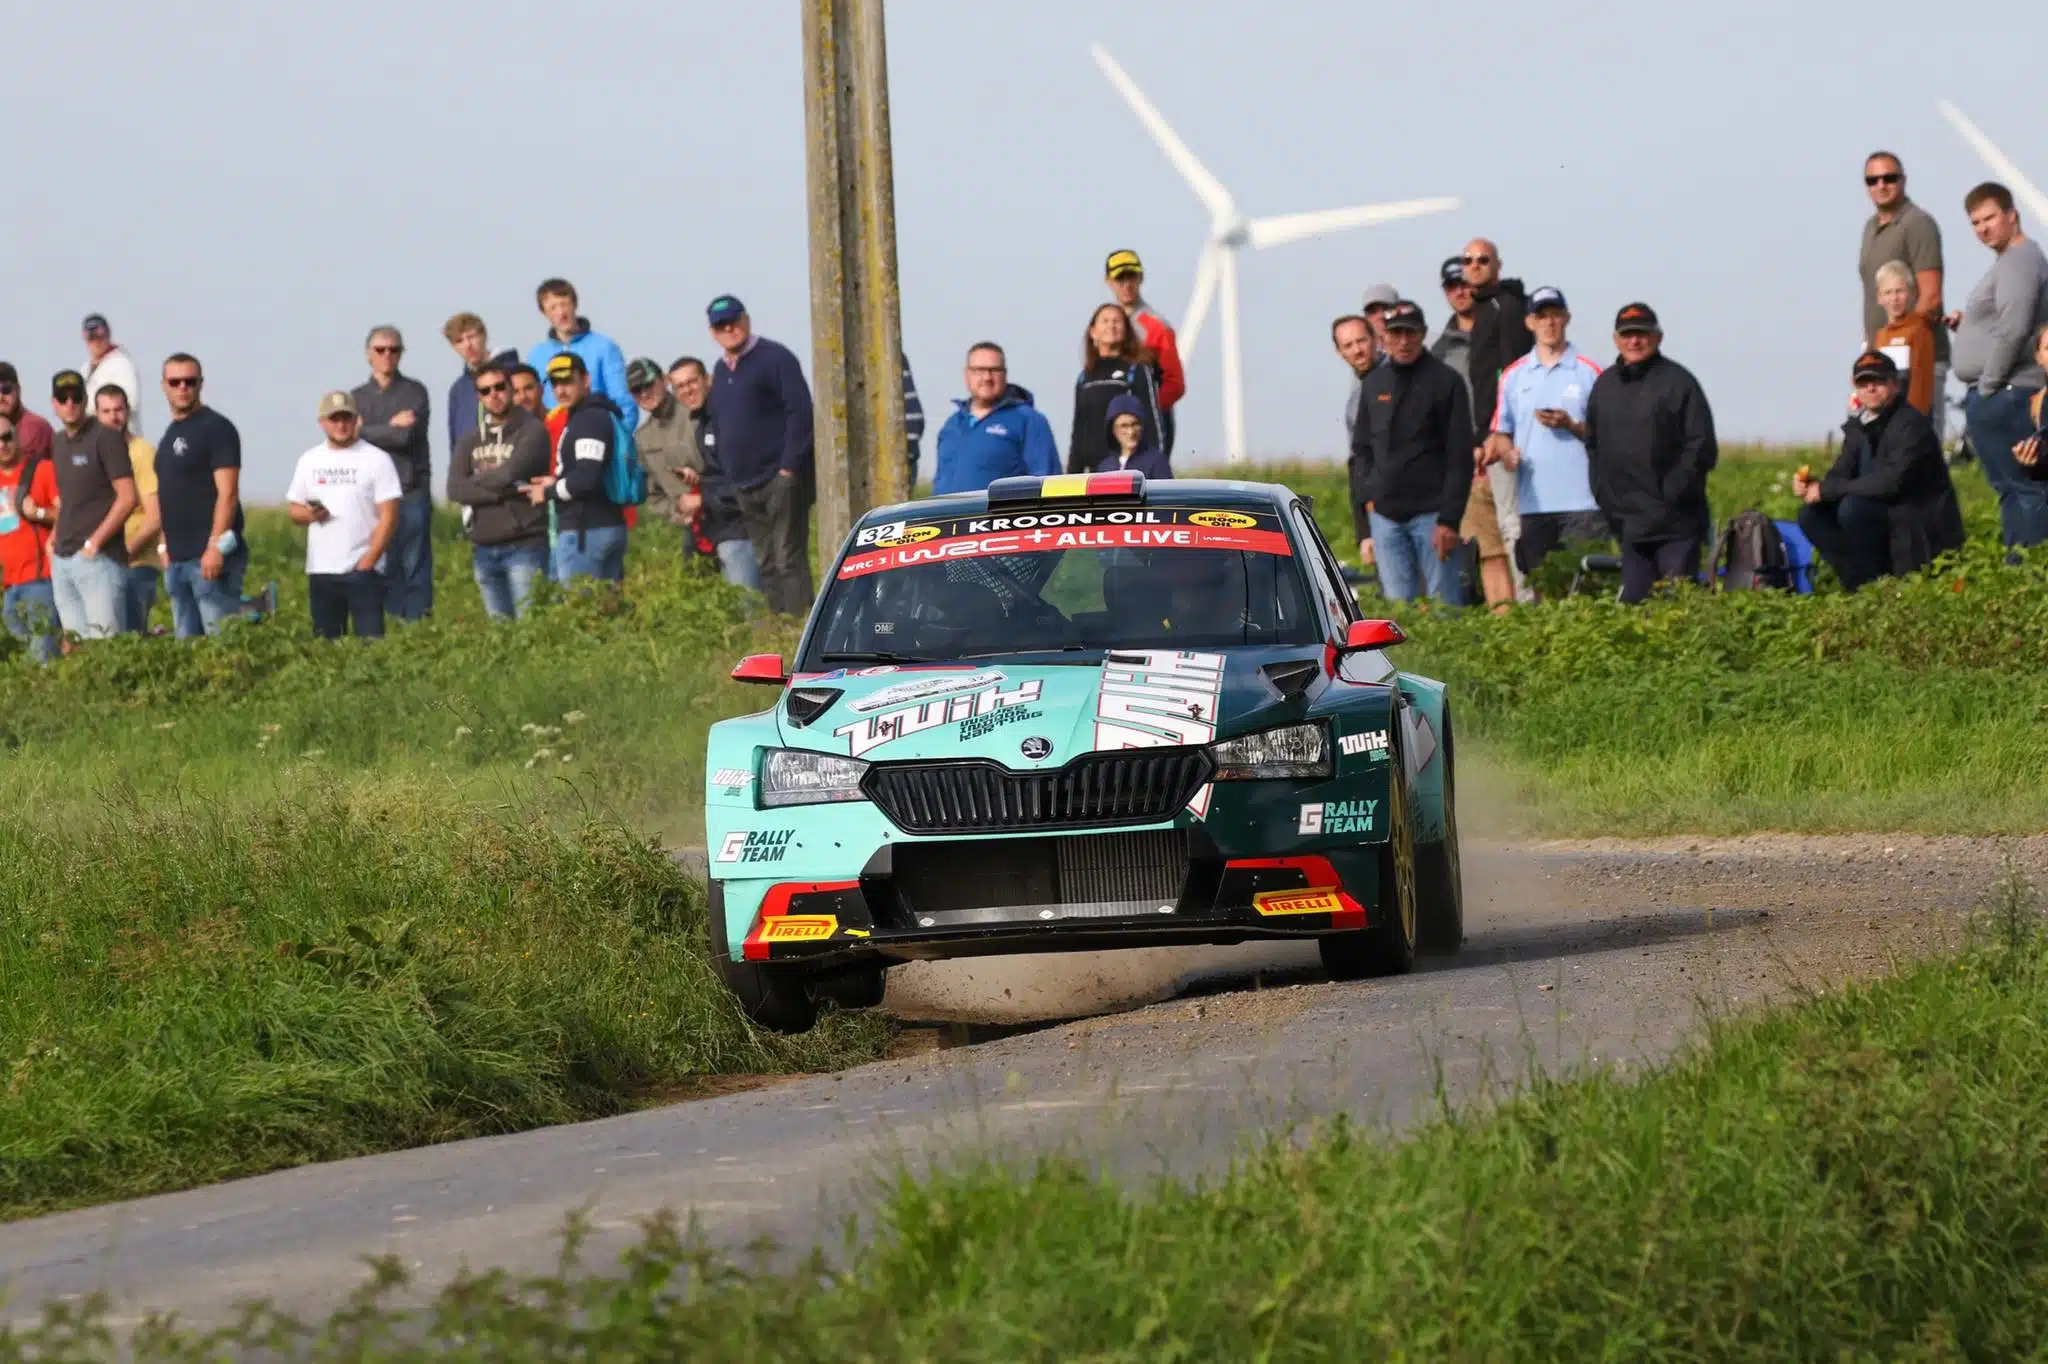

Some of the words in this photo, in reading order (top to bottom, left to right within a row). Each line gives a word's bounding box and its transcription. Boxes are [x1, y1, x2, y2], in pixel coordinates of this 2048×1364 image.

[968, 511, 1161, 533] KROON-OIL
[1198, 515, 1248, 525] KROON
[863, 525, 895, 543] 32
[1055, 531, 1114, 546] ALL
[1123, 530, 1191, 544] LIVE
[842, 558, 874, 573] WRC
[877, 556, 888, 566] 3
[1324, 799, 1378, 818] RALLY
[1324, 816, 1373, 834] TEAM
[745, 829, 796, 846] RALLY
[741, 846, 786, 862] TEAM
[1259, 892, 1333, 912] PIRELLI
[767, 920, 832, 937] PIRELLI
